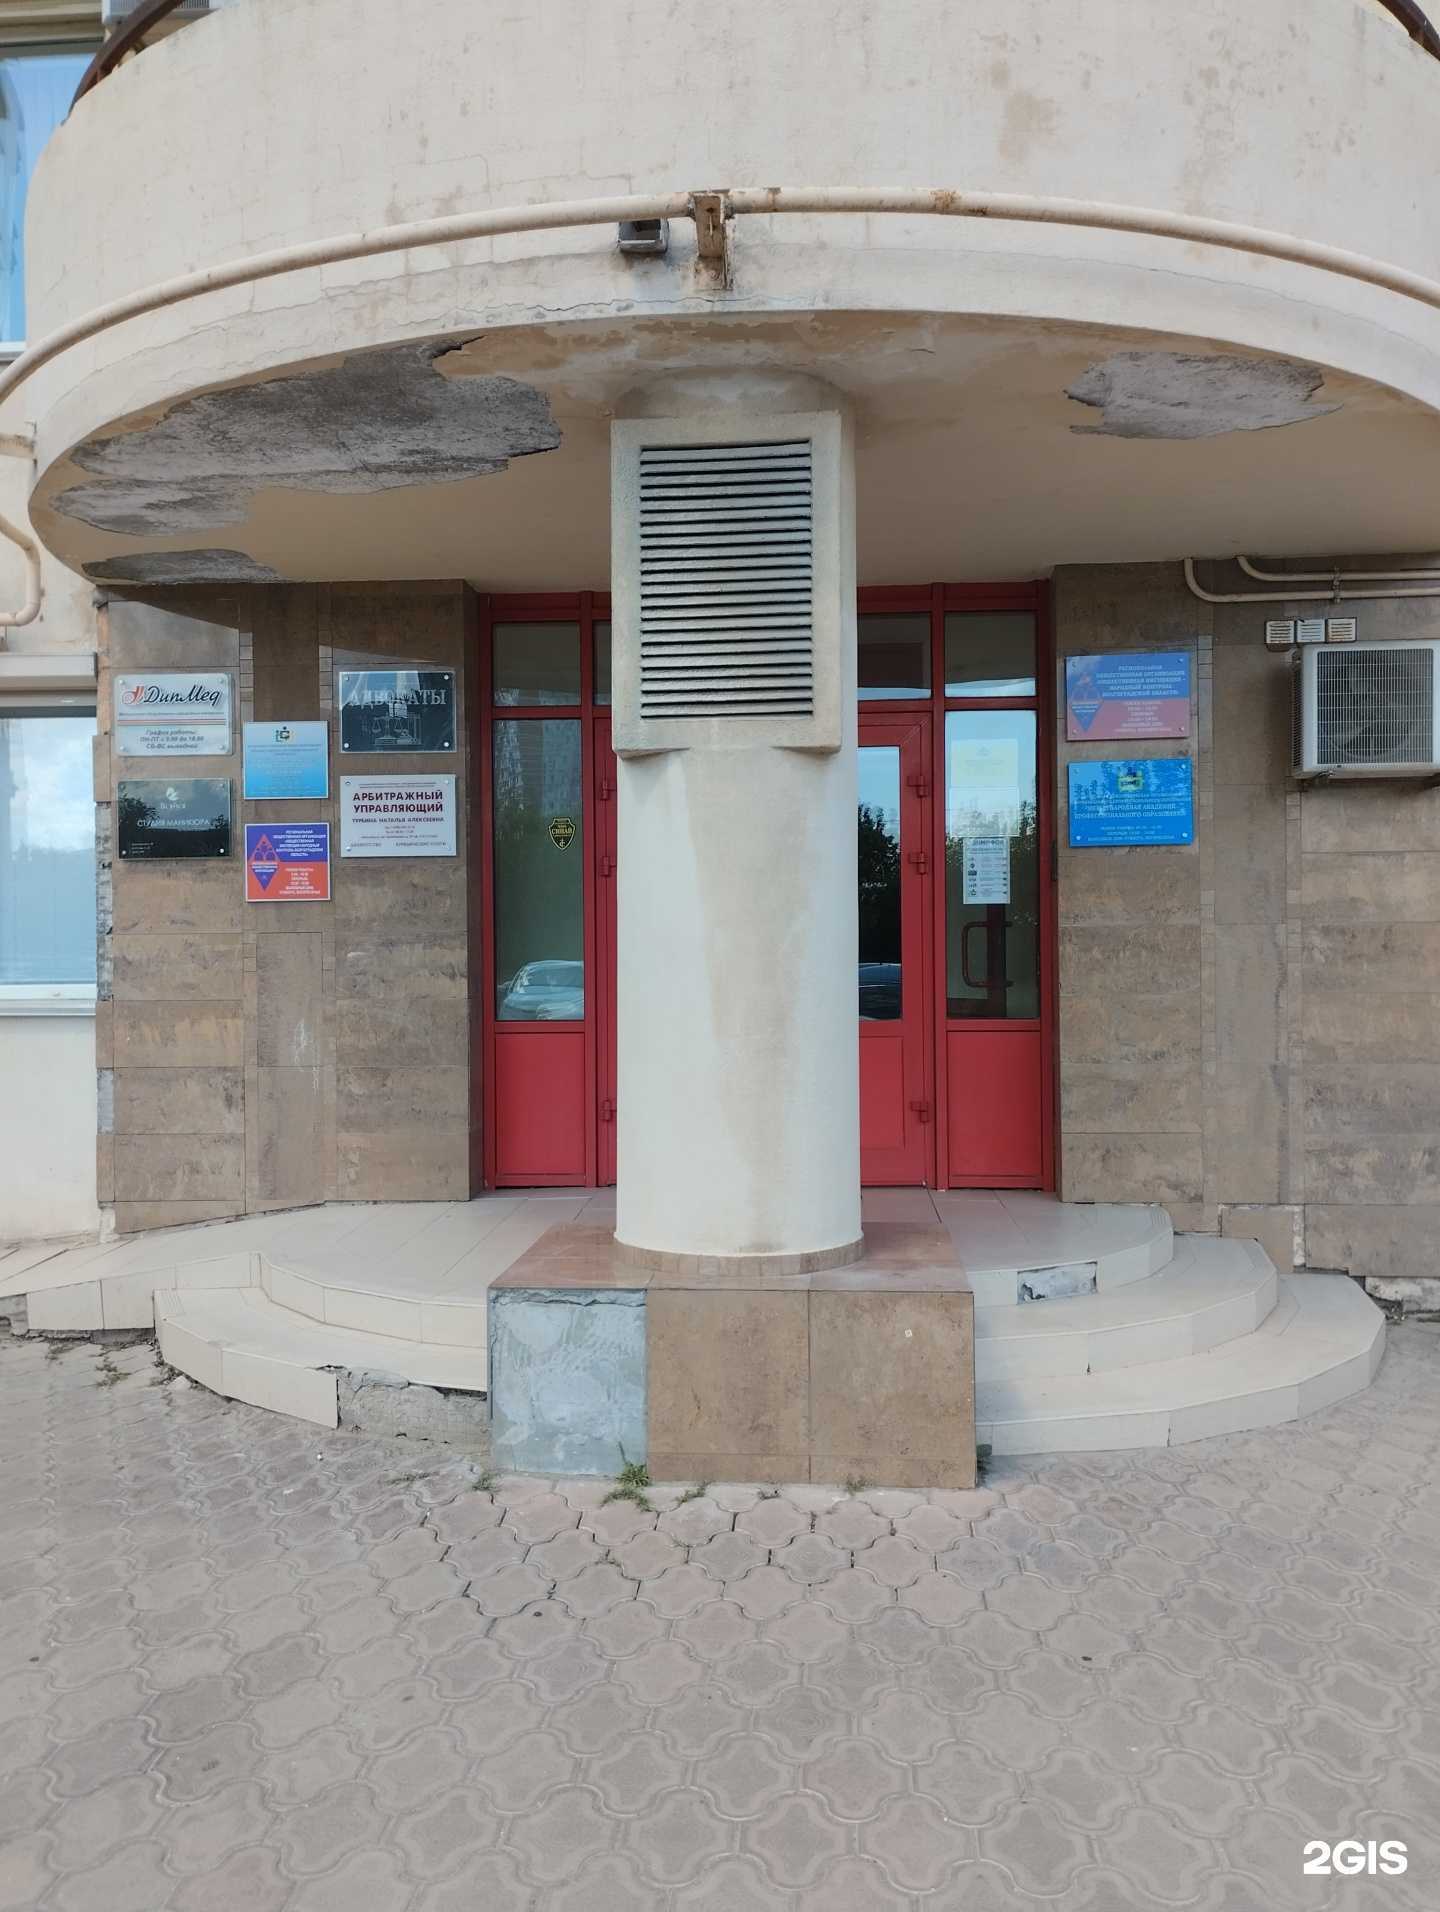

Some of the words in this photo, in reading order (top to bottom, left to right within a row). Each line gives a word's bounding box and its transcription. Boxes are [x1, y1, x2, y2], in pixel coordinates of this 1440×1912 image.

[144, 685, 220, 706] ДипМед
[349, 688, 447, 709] АДВОКАТЫ
[353, 789, 443, 801] АРБИТРАЖНЫЙ
[353, 801, 443, 814] УПРАВЛЯЮЩИЙ
